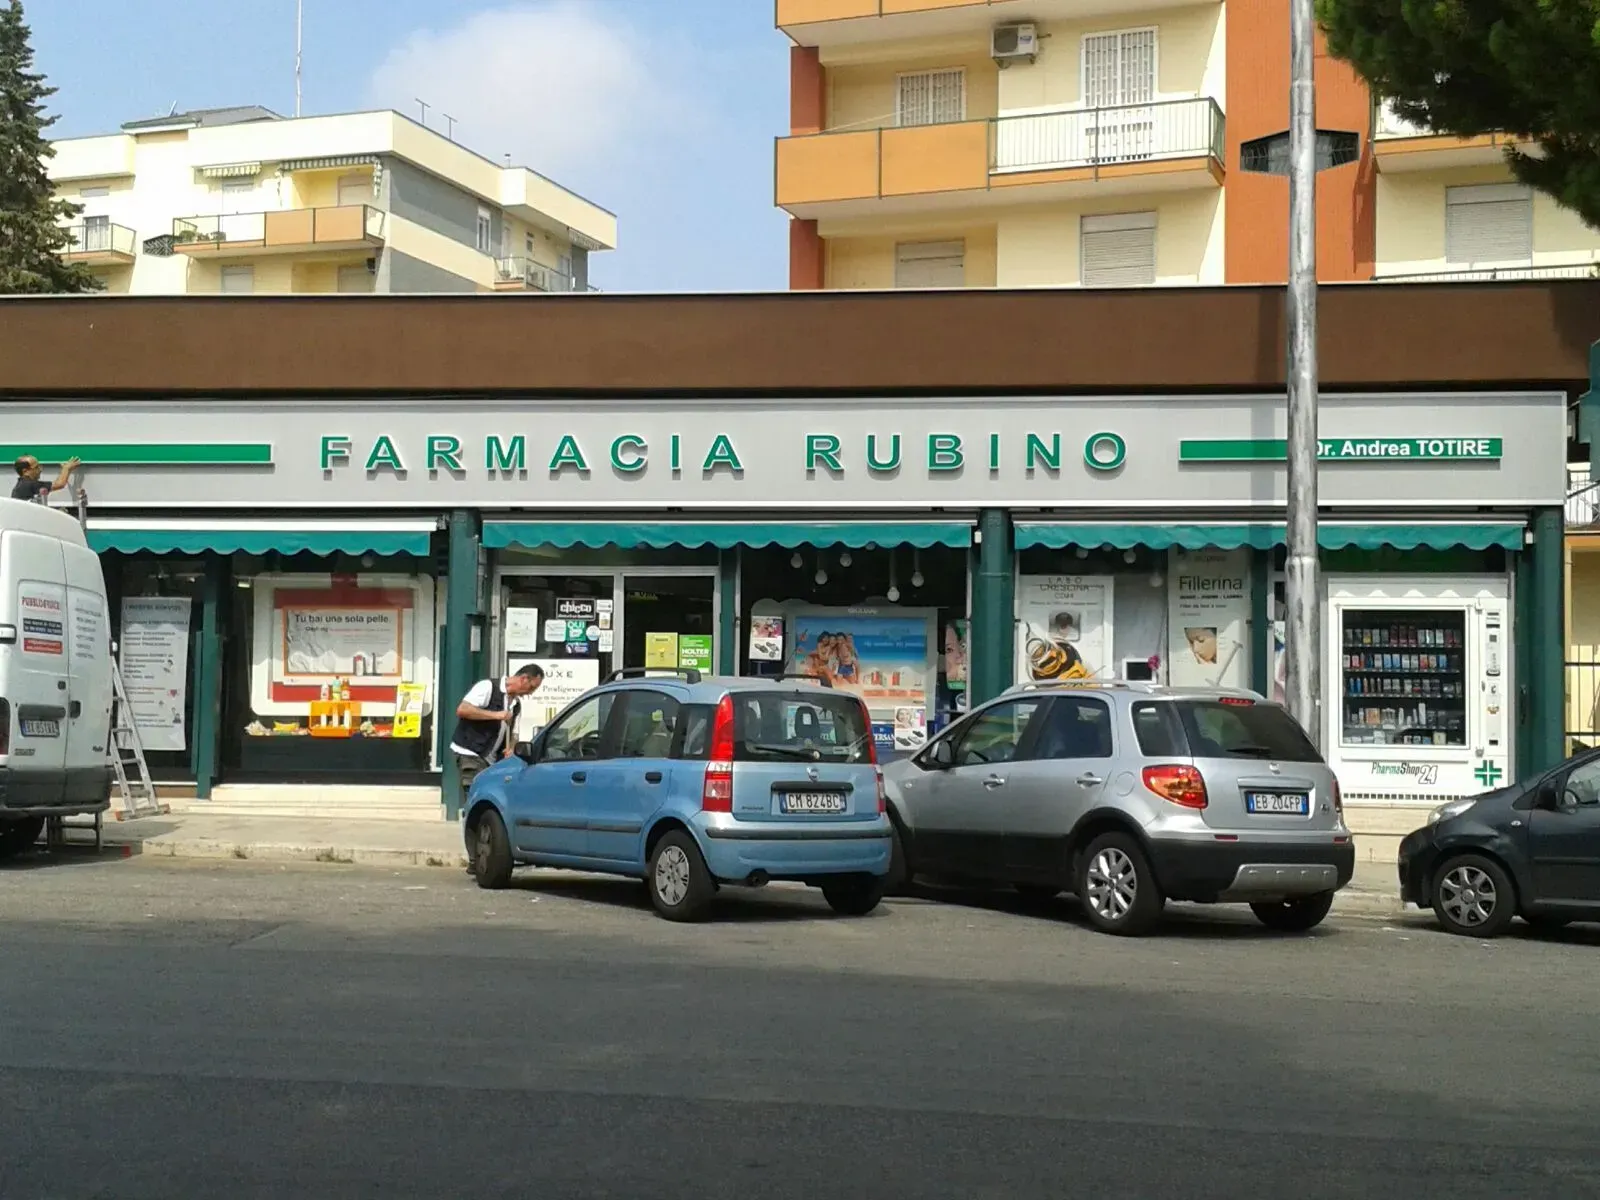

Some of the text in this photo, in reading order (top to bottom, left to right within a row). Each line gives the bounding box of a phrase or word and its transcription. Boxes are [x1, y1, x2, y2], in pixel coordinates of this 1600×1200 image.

[320, 431, 1127, 471] FARMACIA RUBINO
[1340, 440, 1411, 456] Andrea
[1415, 439, 1491, 456] TOTIRE
[1179, 575, 1243, 591] Fillerina
[560, 601, 592, 613] chicco
[295, 614, 306, 623] Tu
[545, 670, 573, 678] UXE
[788, 793, 841, 809] CM 824BC
[1255, 795, 1301, 811] EB 204FP
